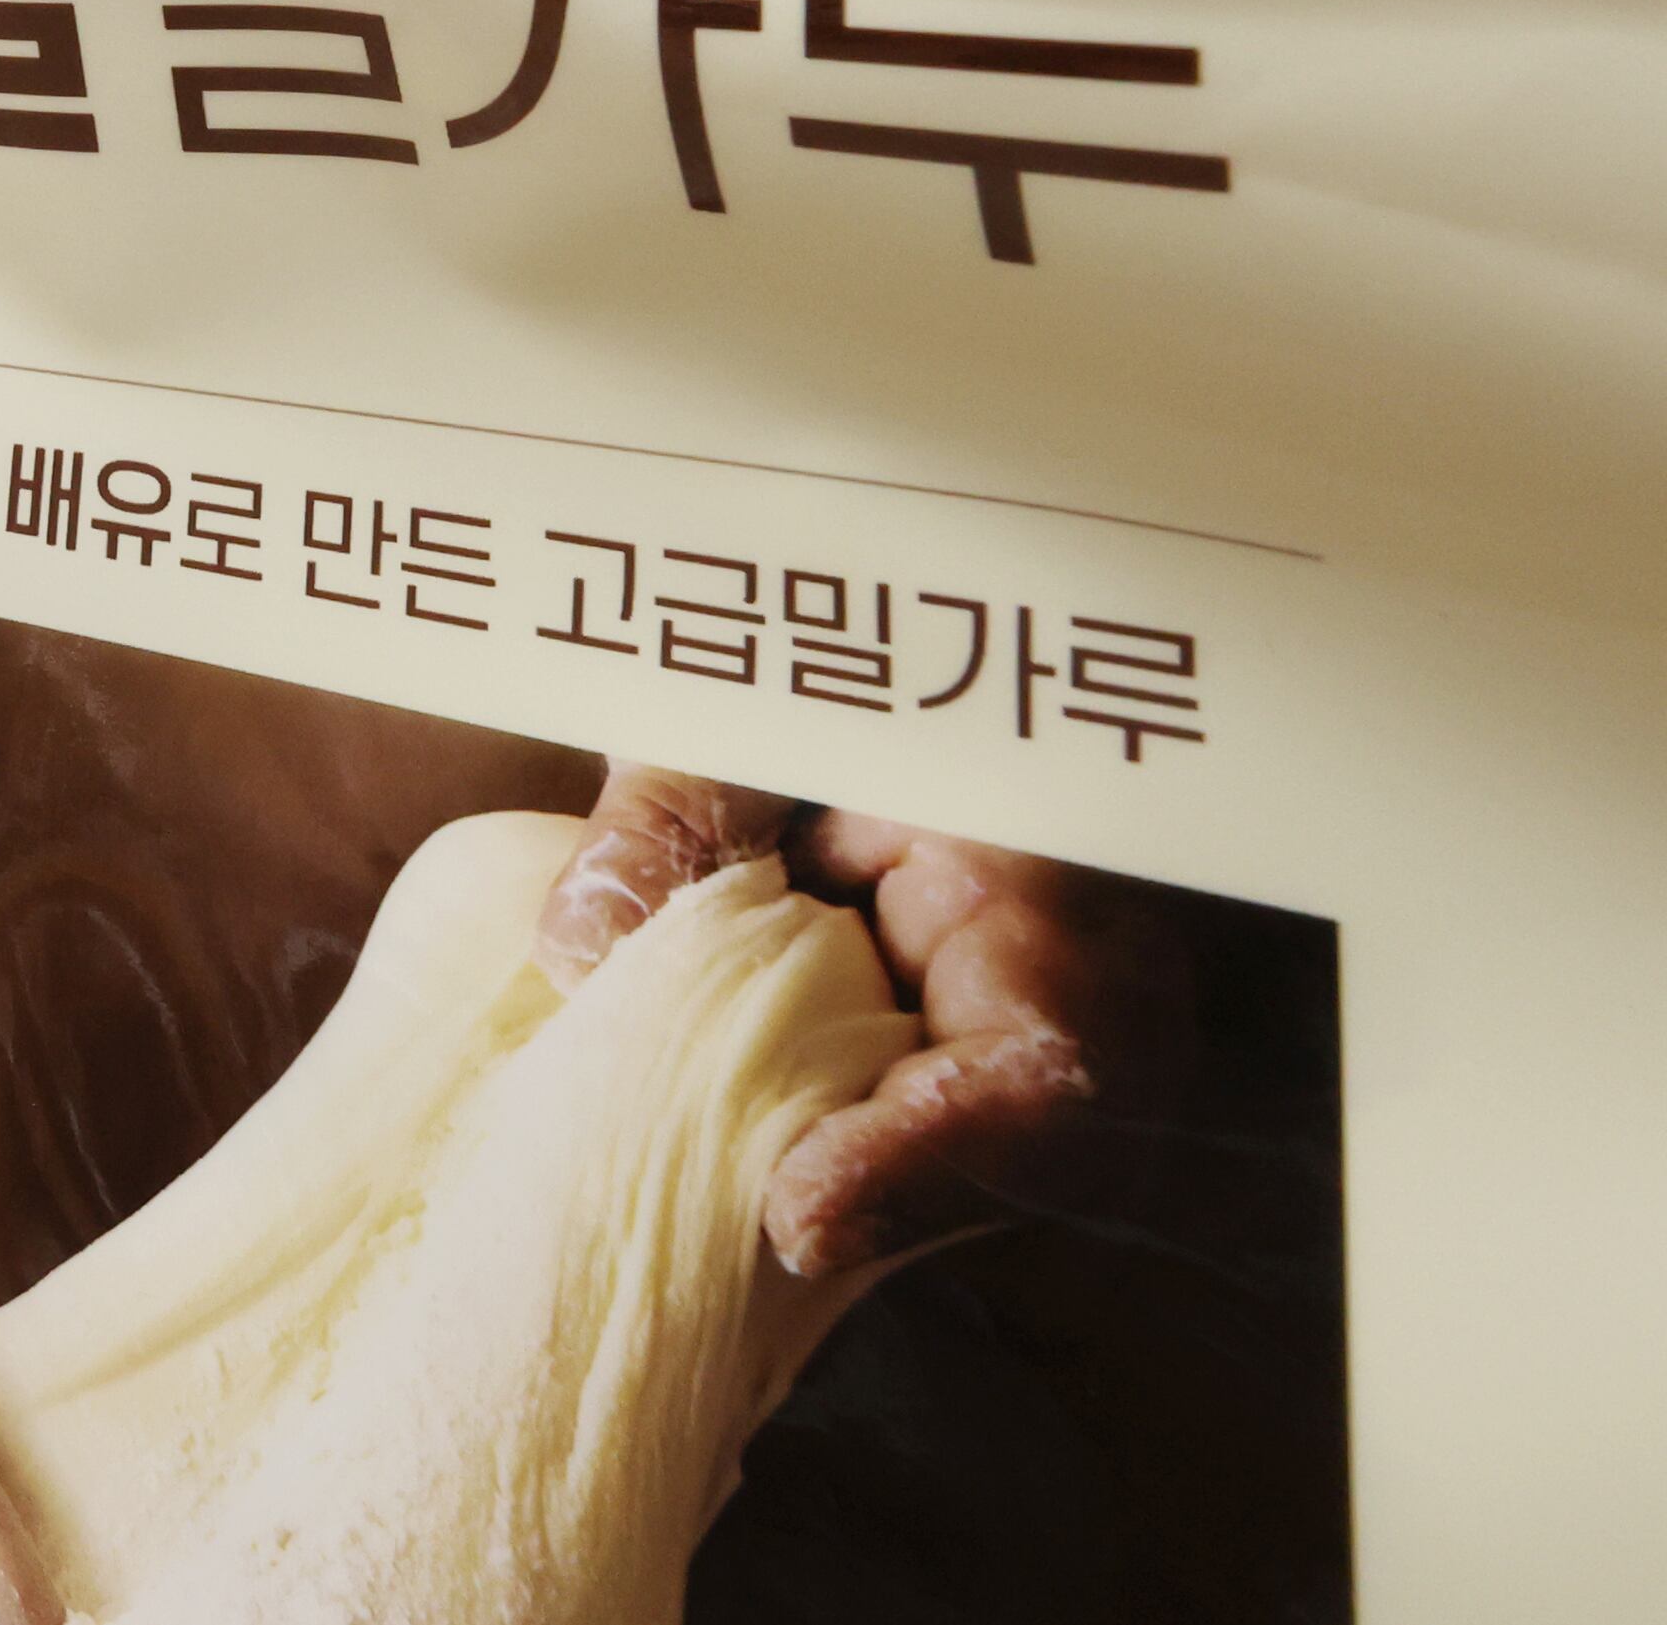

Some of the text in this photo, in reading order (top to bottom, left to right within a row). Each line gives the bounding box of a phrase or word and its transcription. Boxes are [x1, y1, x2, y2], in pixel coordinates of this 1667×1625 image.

[4, 443, 266, 583] 배유로
[302, 488, 498, 633] 만든
[534, 527, 1206, 765] 고급밀가루
